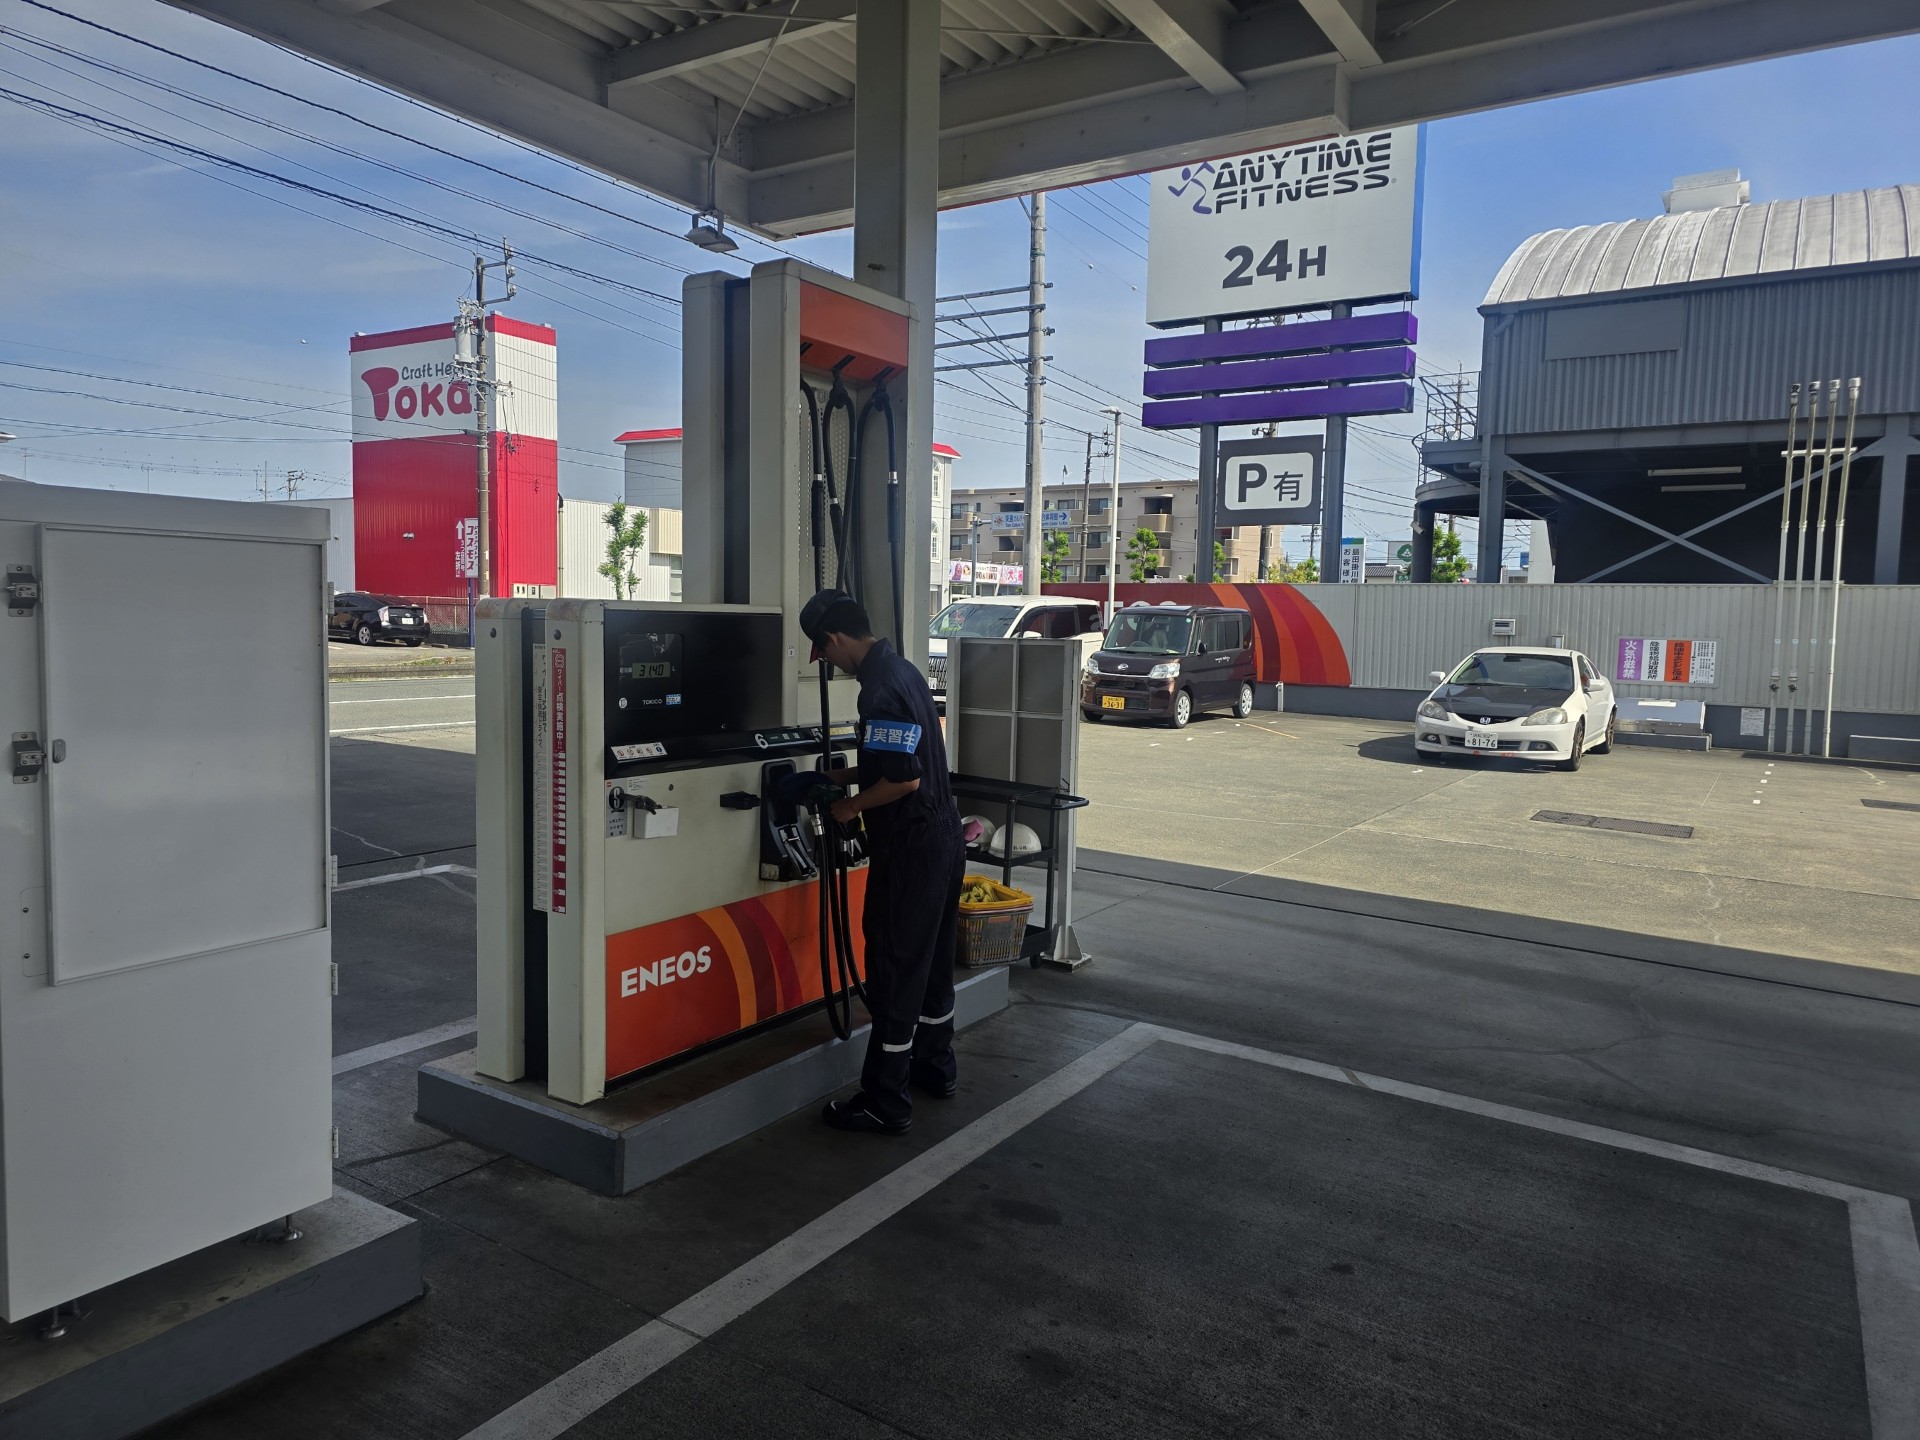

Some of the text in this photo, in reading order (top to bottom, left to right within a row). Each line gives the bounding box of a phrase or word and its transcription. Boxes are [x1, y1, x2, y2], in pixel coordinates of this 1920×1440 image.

[1213, 132, 1392, 190] ANYTIME
[1215, 164, 1390, 214] FITNESS
[1222, 239, 1327, 289] 24H
[401, 363, 433, 380] Craft
[466, 526, 475, 570] コスモス
[1623, 641, 1637, 679] 火気厳禁
[754, 733, 769, 749] 6
[872, 727, 917, 747] 実習生
[621, 945, 712, 998] ENEOS
